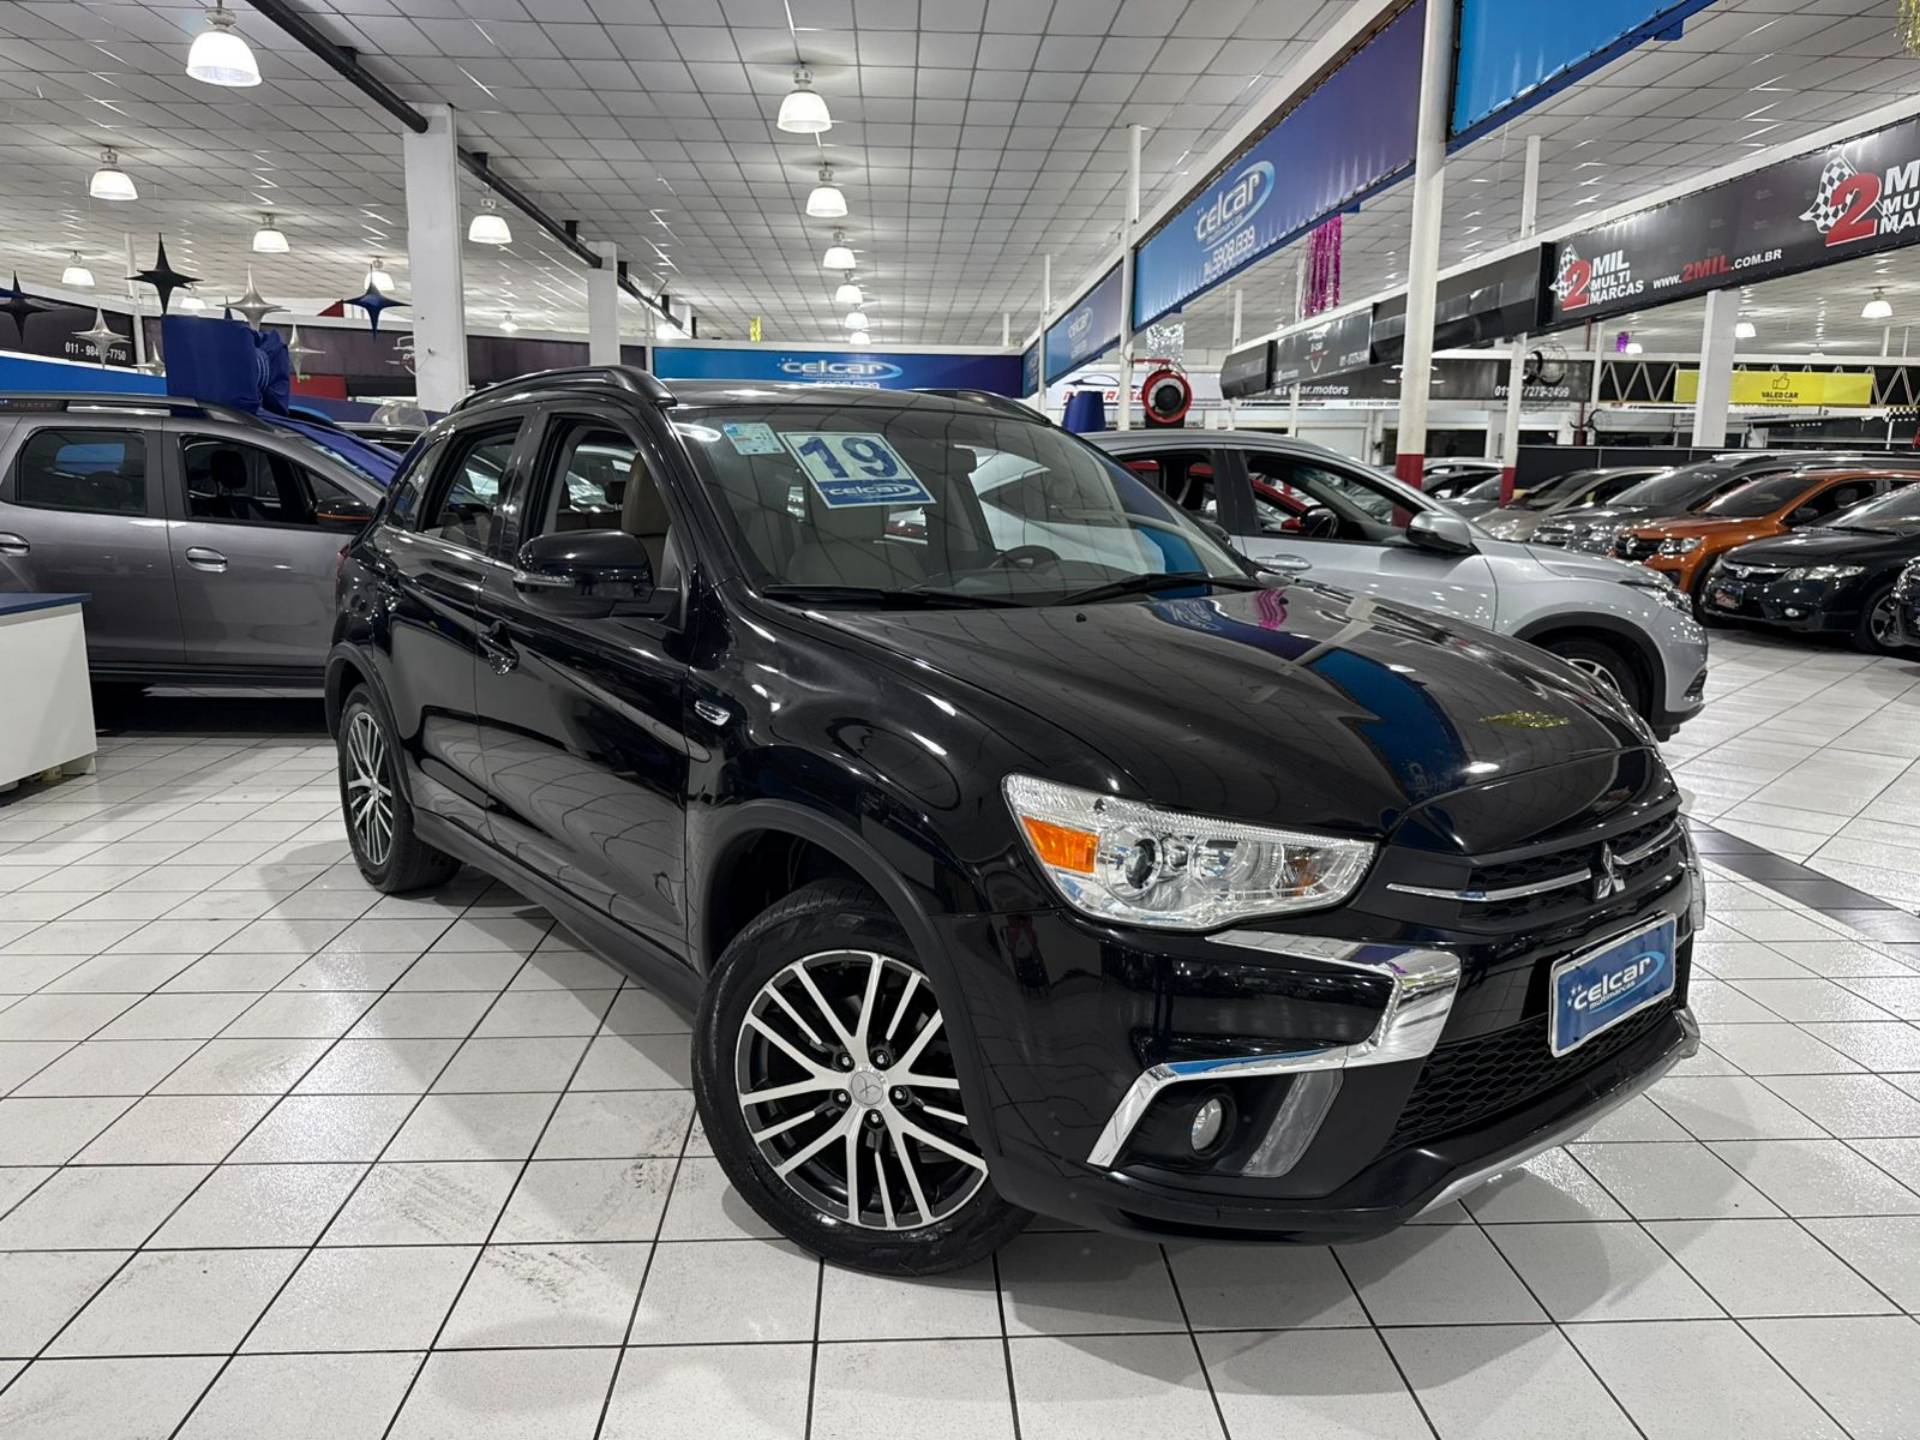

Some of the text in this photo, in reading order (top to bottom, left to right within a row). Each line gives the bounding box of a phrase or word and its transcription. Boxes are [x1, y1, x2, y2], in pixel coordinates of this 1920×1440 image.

[1197, 173, 1260, 241] celcar
[1824, 171, 1882, 247] 2
[1880, 209, 1920, 234] MA
[1562, 250, 1630, 311] 2 MIL
[1589, 280, 1644, 304] MARCAS
[1590, 271, 1631, 290] MULTI
[65, 341, 79, 353] 011
[782, 360, 883, 374] celcar
[797, 436, 898, 478] 19
[829, 484, 907, 495] celcar
[1574, 957, 1652, 1010] celcar
